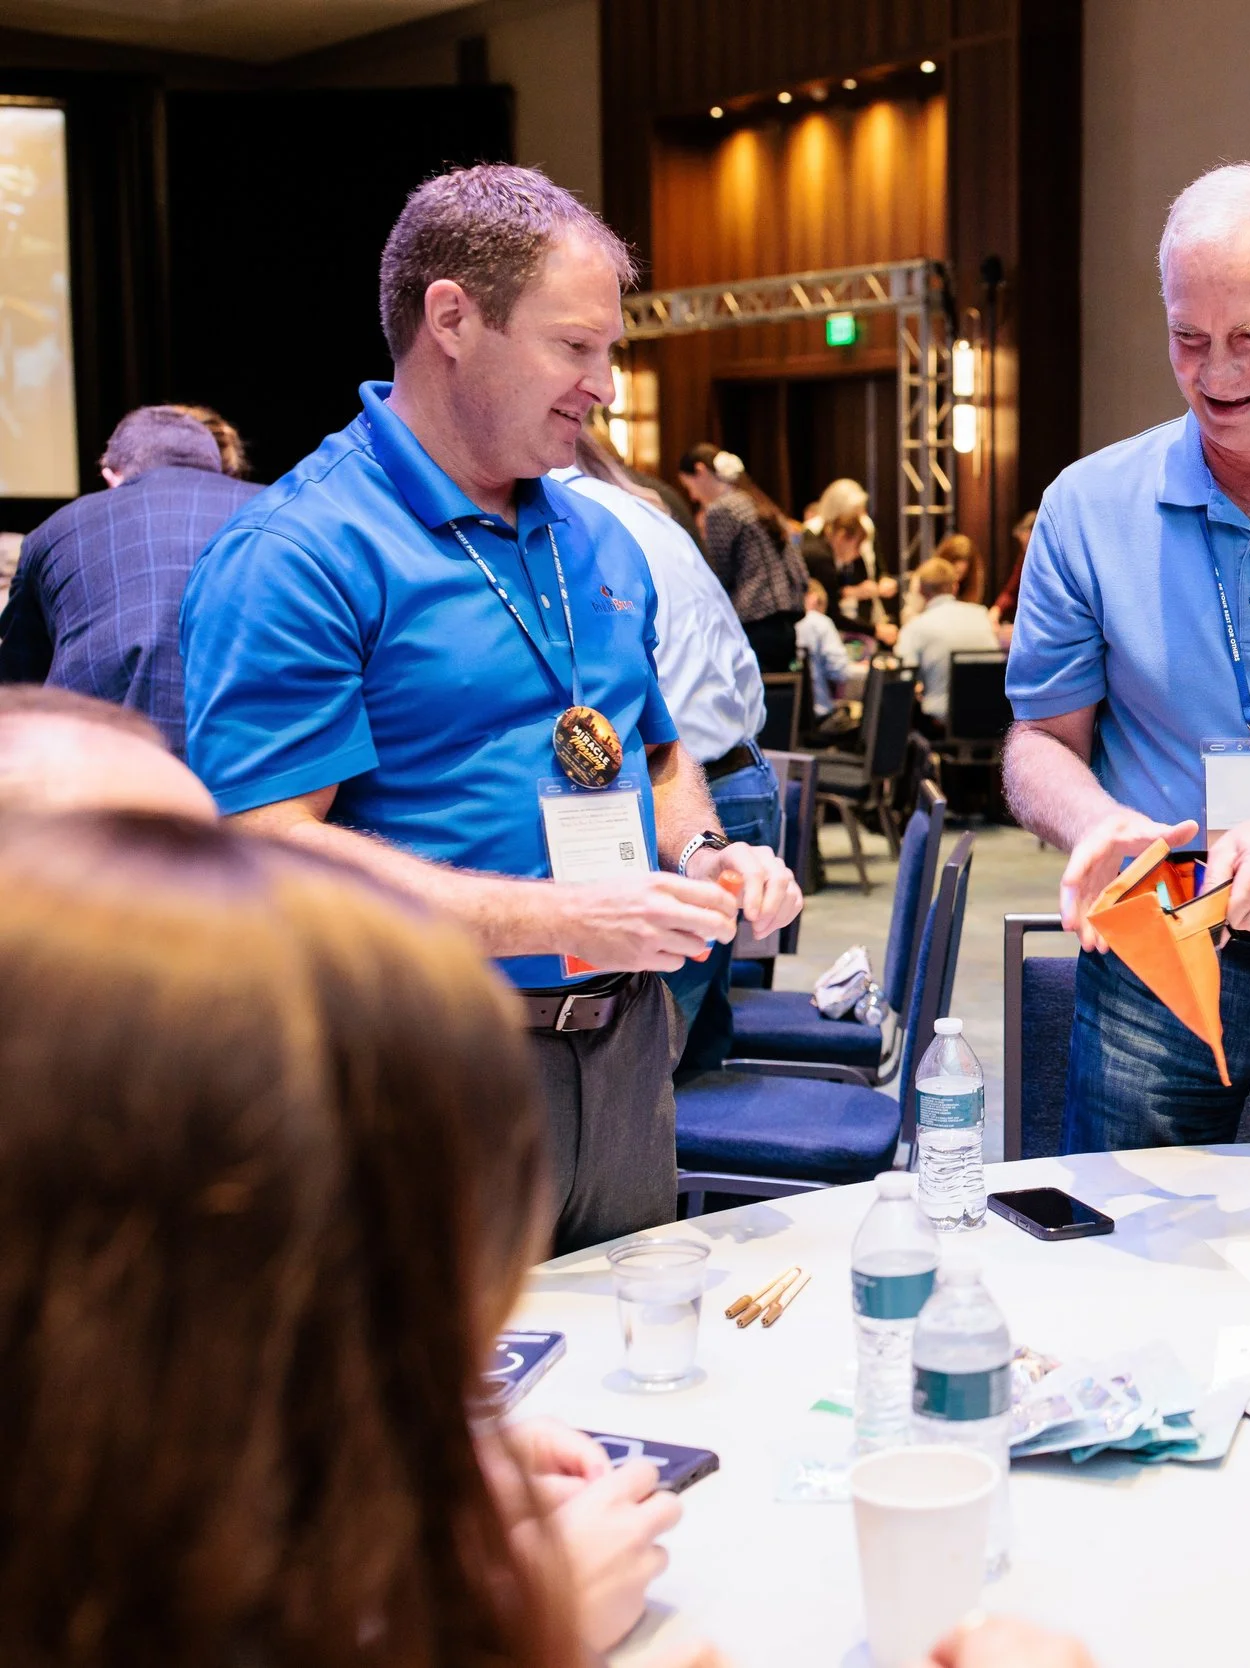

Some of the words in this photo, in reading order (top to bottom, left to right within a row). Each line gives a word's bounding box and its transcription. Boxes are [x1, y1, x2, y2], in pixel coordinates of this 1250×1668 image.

[1218, 582, 1224, 591] BE
[1220, 592, 1228, 608] YOUR
[1231, 638, 1240, 662] OTHERS
[569, 735, 606, 771] Morning
[572, 725, 610, 765] MIRACLE
